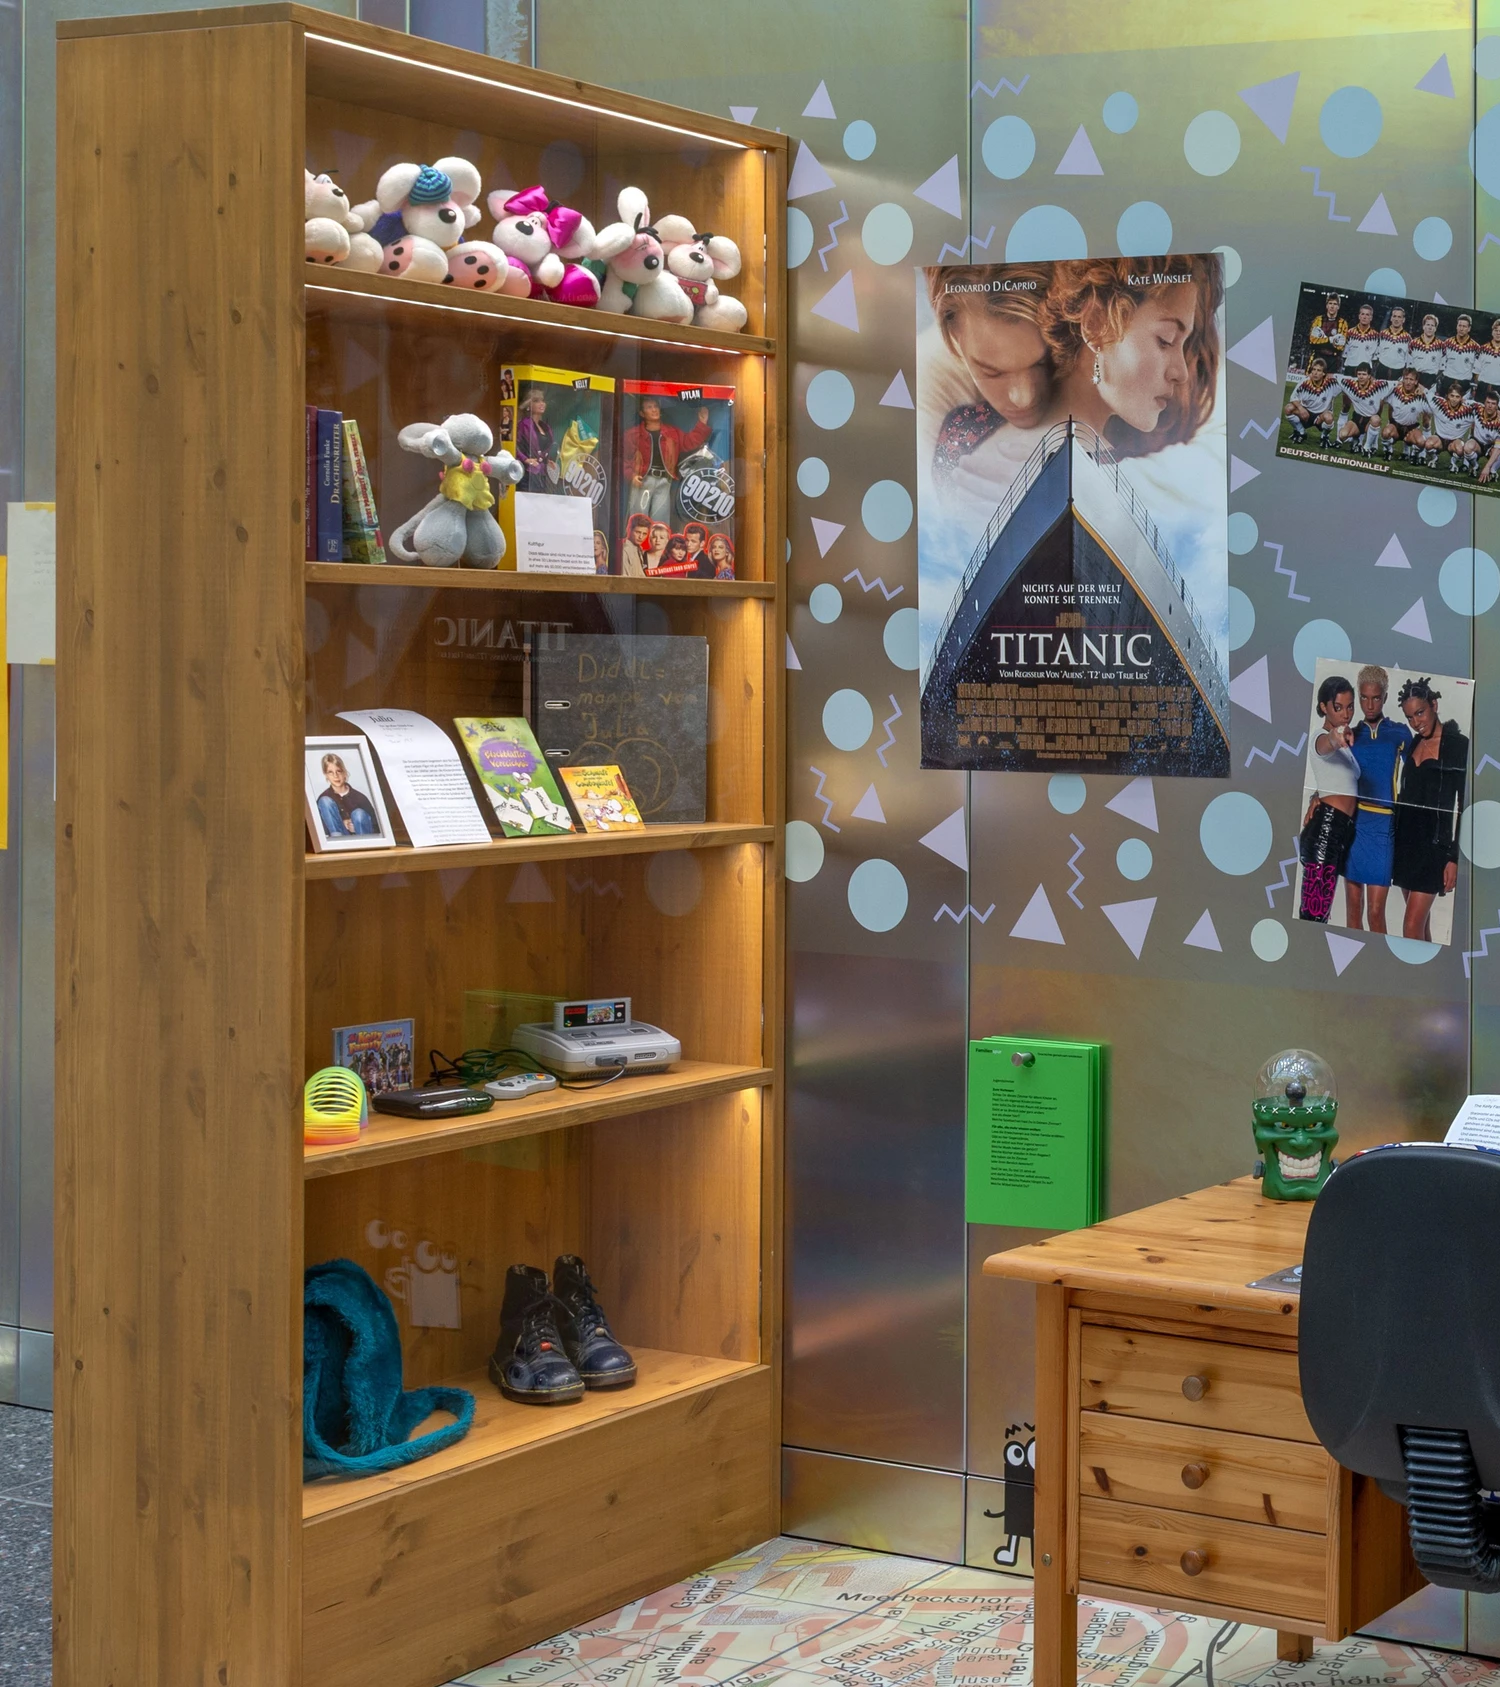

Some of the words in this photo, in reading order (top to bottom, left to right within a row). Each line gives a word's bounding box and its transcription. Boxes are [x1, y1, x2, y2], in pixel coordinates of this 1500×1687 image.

[945, 282, 991, 294] LEONARDO
[1128, 274, 1151, 286] KATE
[1153, 273, 1192, 285] WINSLET
[576, 379, 588, 389] KELLY
[680, 390, 700, 400] DYLAN
[331, 424, 340, 504] DRACHENREITER
[1280, 446, 1330, 463] DEUTSCHE
[1330, 455, 1390, 473] NATIONALELF
[565, 460, 604, 505] 90210
[683, 475, 735, 518] 90210
[1022, 584, 1055, 593] NICHTS
[1058, 584, 1075, 593] AUF
[1078, 584, 1096, 594] DER
[1098, 584, 1122, 594] WELT
[1024, 594, 1060, 605] KONNTE
[1062, 595, 1077, 605] SIE
[1079, 595, 1122, 605] TRENNEN.
[990, 633, 1152, 666] TITANIC
[696, 1578, 735, 1604] kamp
[949, 1612, 1017, 1645] gärten
[1102, 1612, 1135, 1638] kamp
[595, 1646, 672, 1682] gärten
[1317, 1641, 1373, 1676] gärten
